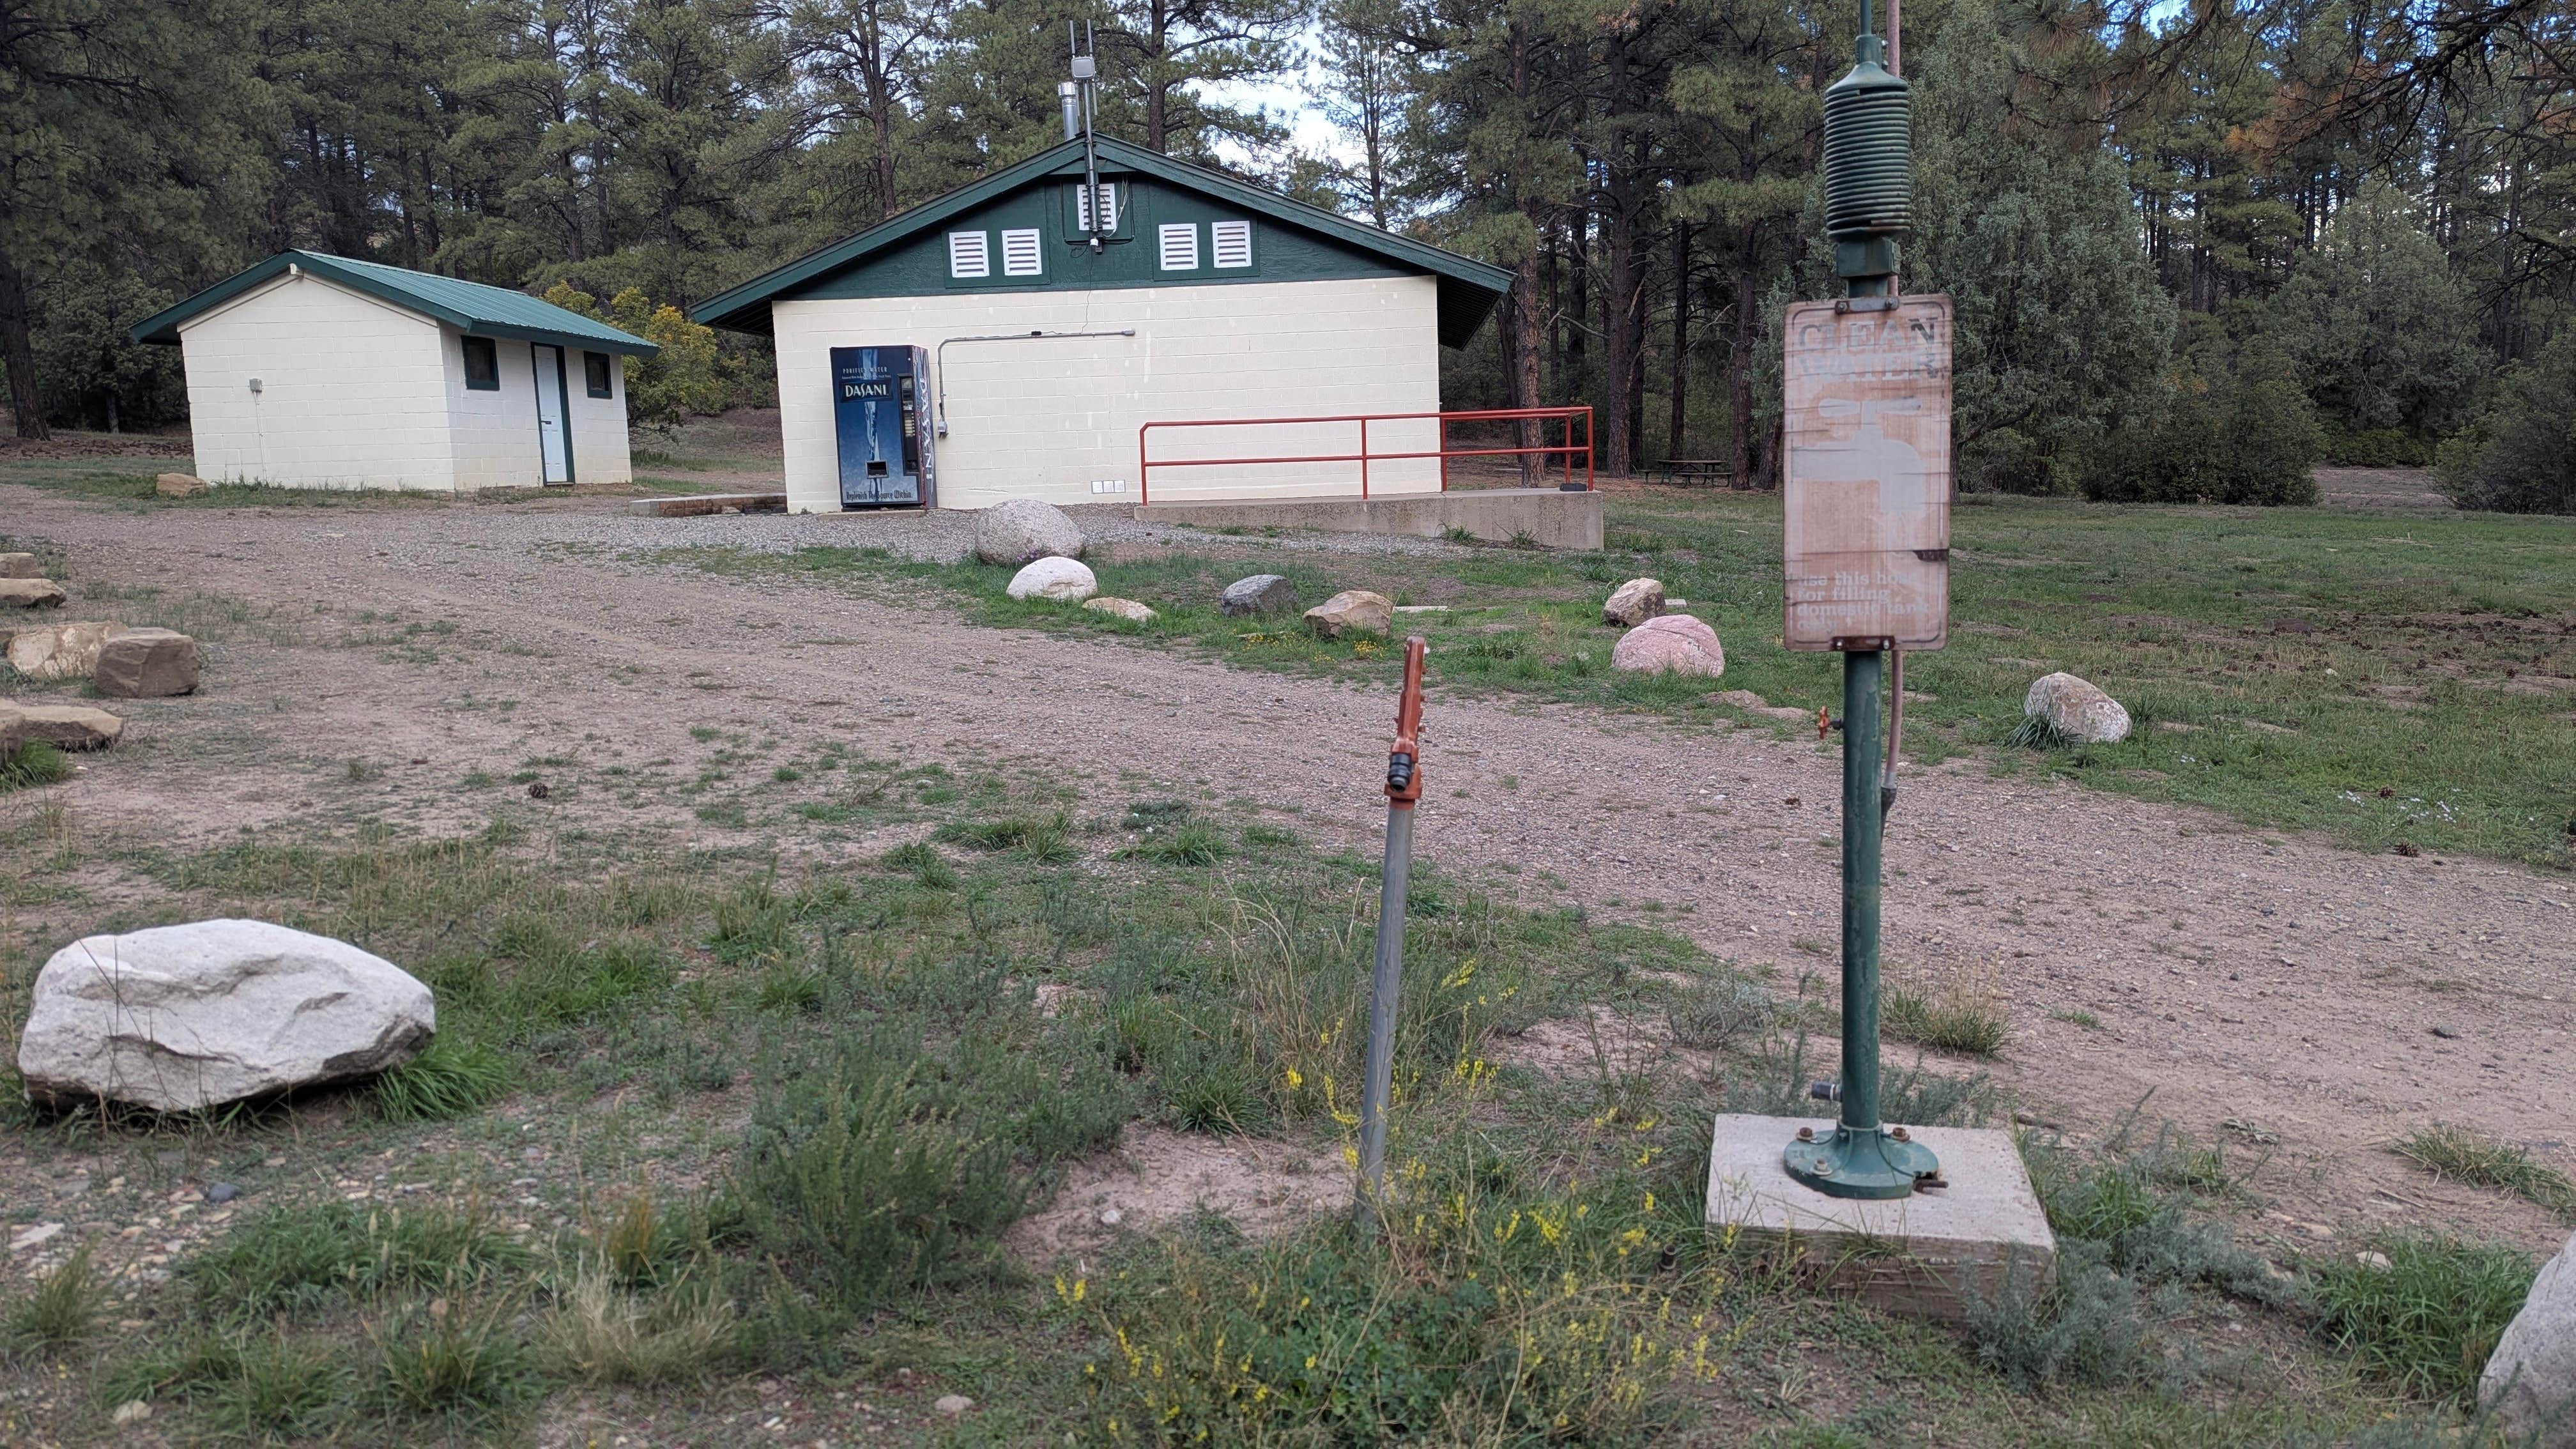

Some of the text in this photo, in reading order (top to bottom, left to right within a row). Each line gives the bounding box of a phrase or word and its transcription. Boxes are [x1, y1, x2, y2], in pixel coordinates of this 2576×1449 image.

[1798, 317, 1940, 350] CLEAN
[1797, 352, 1940, 382] WATER
[845, 383, 887, 397] DASANI
[920, 378, 933, 480] DASANI
[1835, 571, 1869, 585] this
[1797, 586, 1890, 604] for filling
[1797, 601, 1881, 616] domestic
